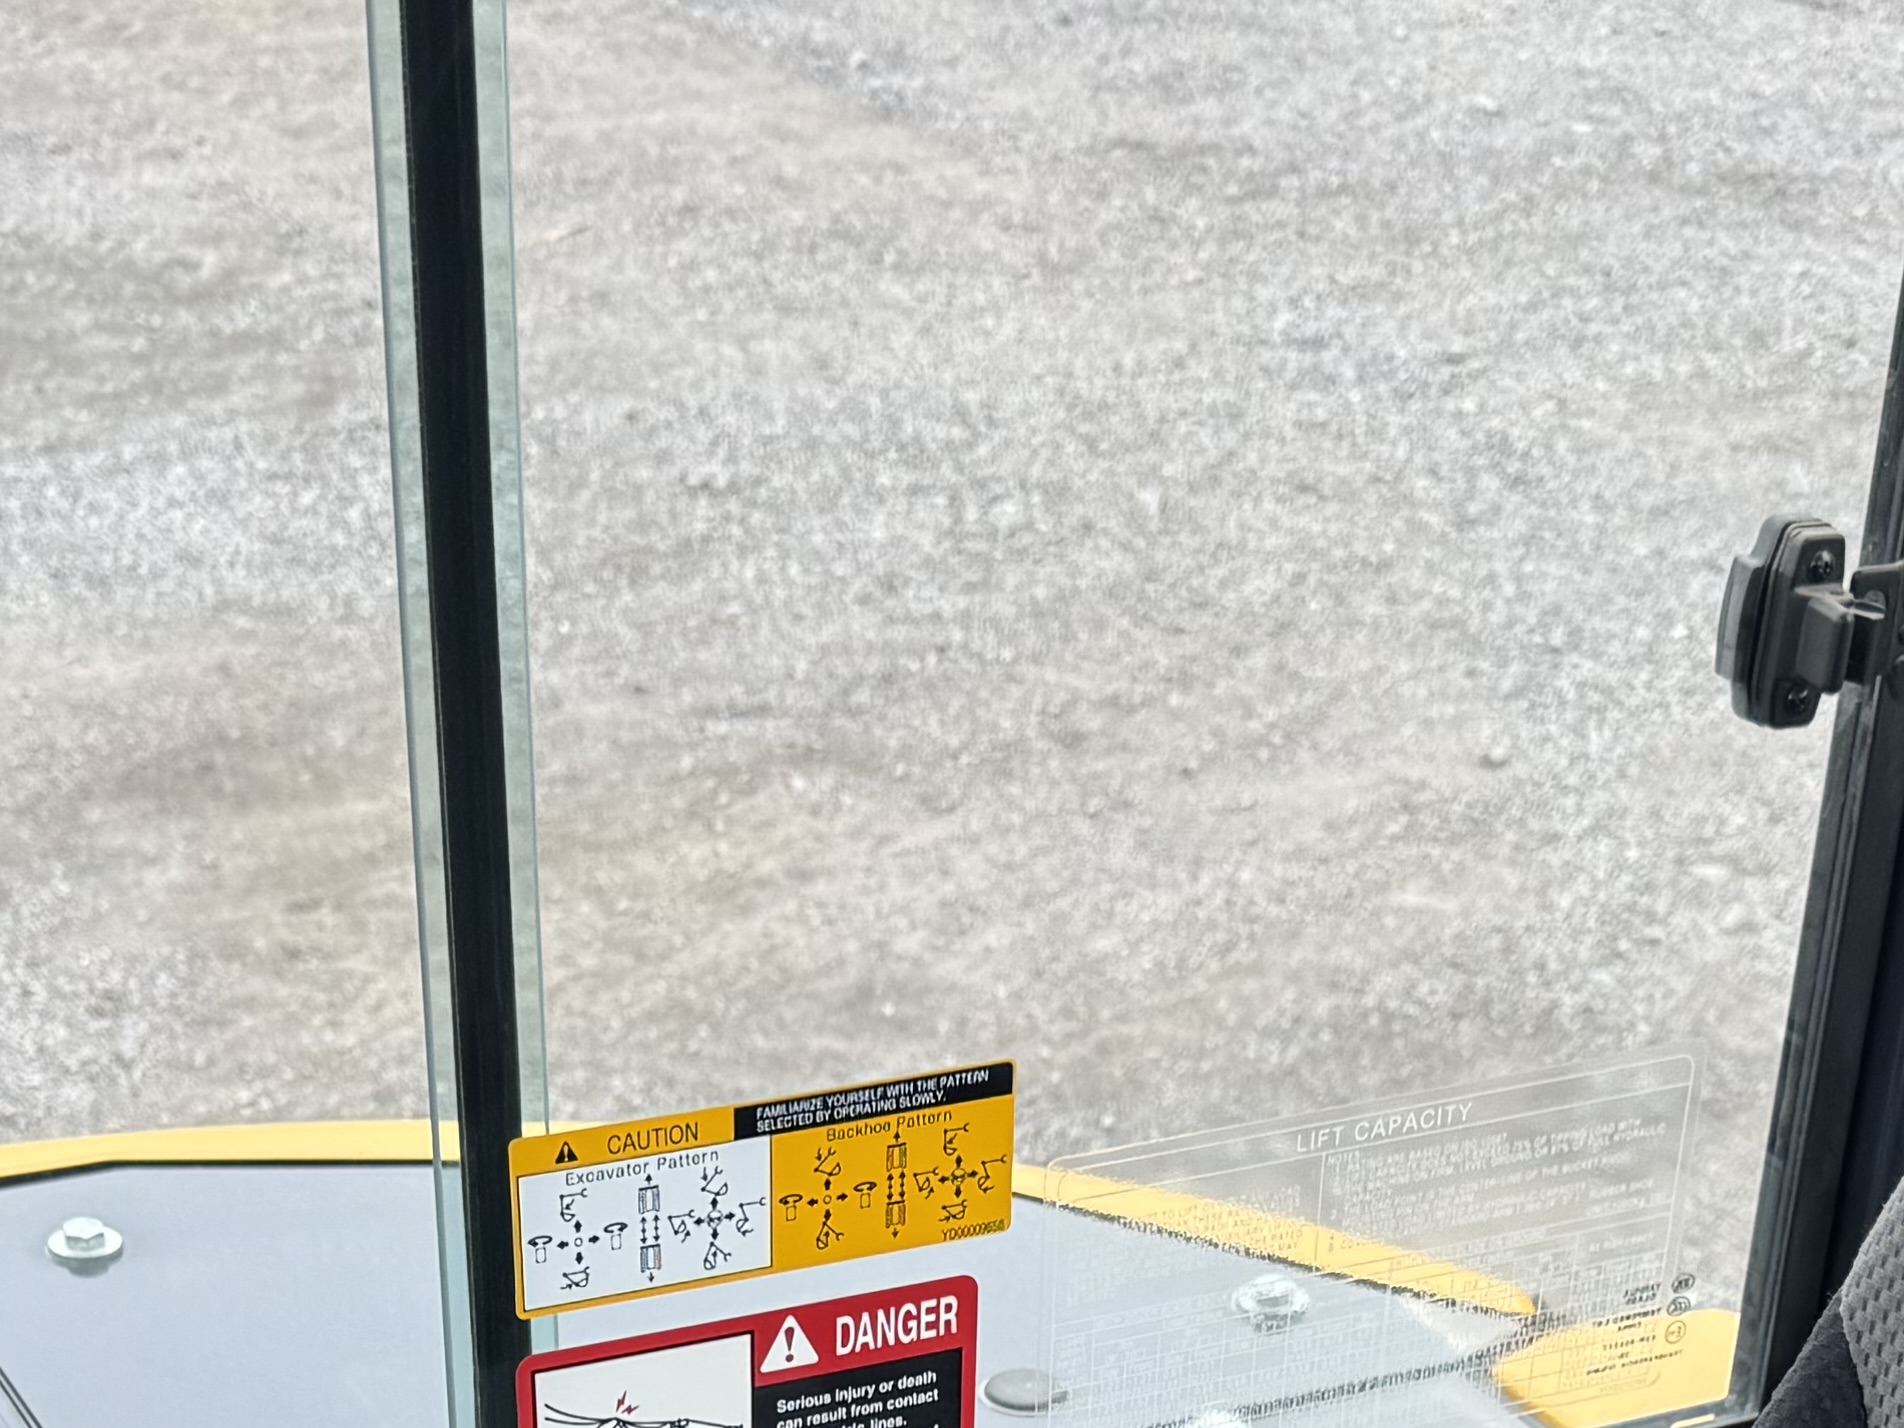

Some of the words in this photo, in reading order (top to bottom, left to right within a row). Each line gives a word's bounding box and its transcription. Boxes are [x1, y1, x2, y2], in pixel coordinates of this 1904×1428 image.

[826, 1086, 884, 1107] YOURSELF
[886, 1081, 914, 1098] WITH
[917, 1078, 936, 1091] THE
[940, 1069, 989, 1088] PATTERN
[757, 1112, 813, 1133] SELECTED
[816, 1109, 831, 1123] BY
[834, 1098, 896, 1119] OPERATING
[827, 1122, 890, 1142] Backhoe
[897, 1110, 952, 1130] Pattern
[1296, 1126, 1345, 1153] LIFT
[1354, 1102, 1473, 1143] CAPACITY
[607, 1122, 698, 1155] CAUTION
[565, 1162, 649, 1186] Excavator
[657, 1151, 718, 1171] Pattern
[836, 1295, 958, 1356] DANGER
[777, 1391, 831, 1413] Serious
[835, 1382, 875, 1403] injury
[879, 1379, 894, 1394] or
[898, 1371, 937, 1391] death
[807, 1407, 846, 1427] result
[850, 1401, 883, 1417] from
[887, 1388, 938, 1409] contact
